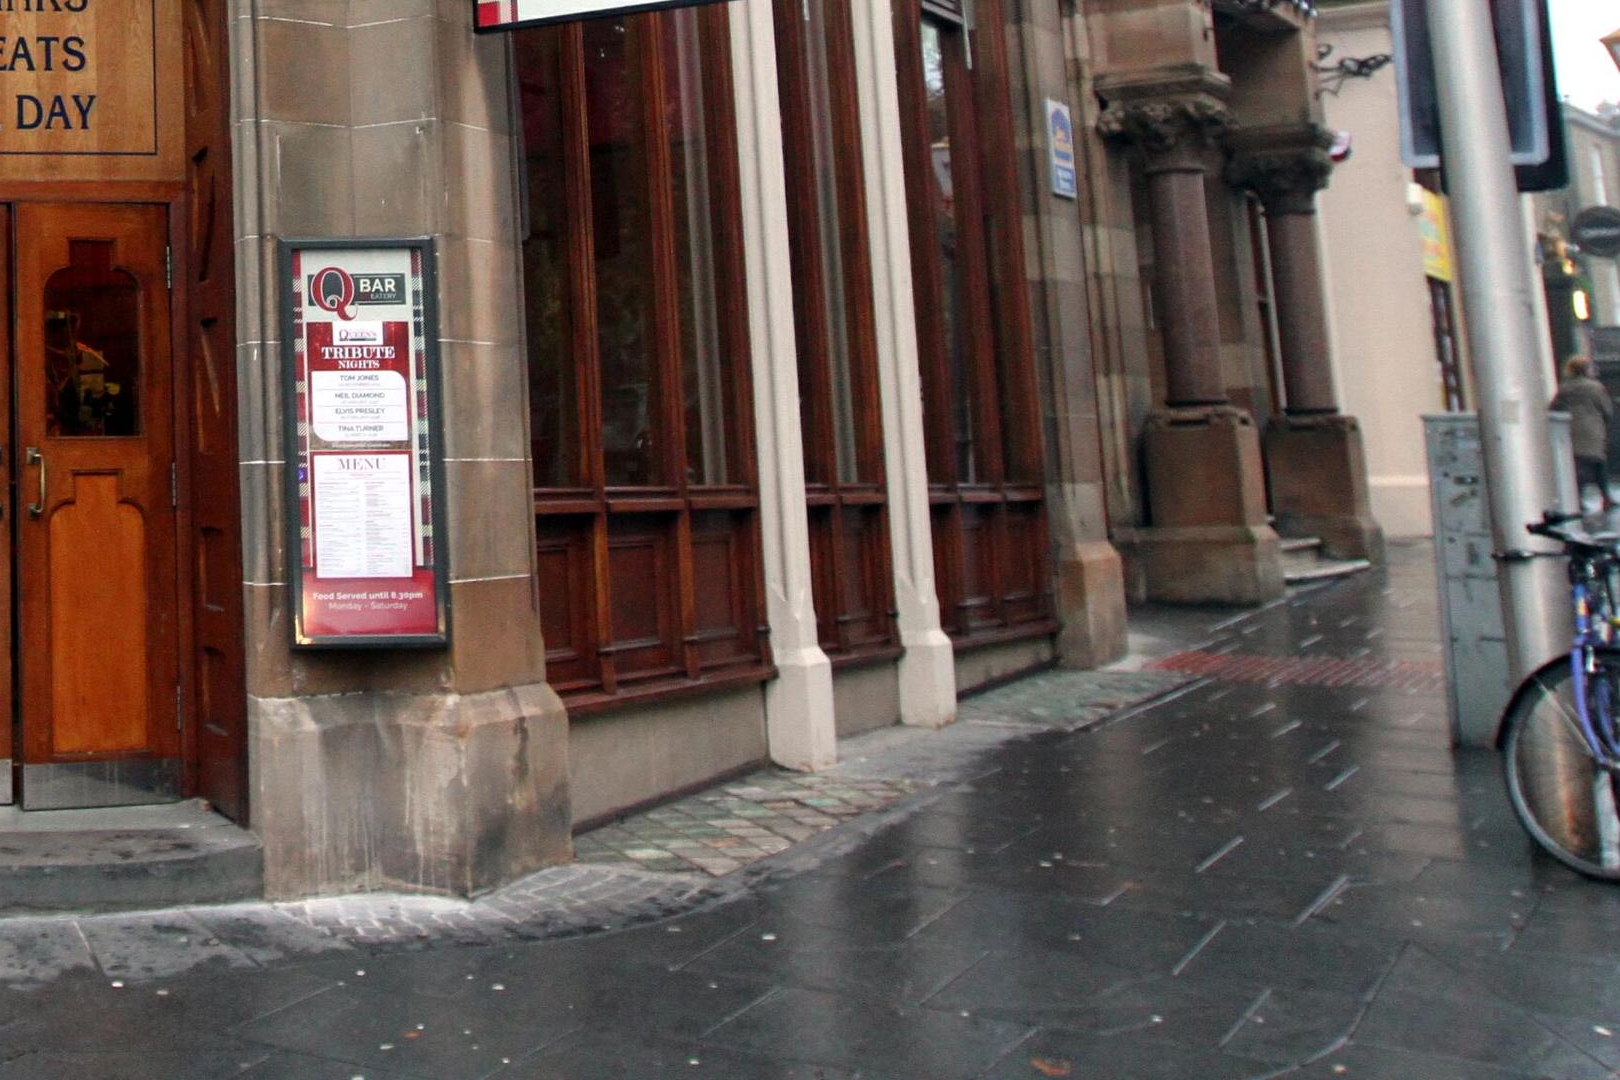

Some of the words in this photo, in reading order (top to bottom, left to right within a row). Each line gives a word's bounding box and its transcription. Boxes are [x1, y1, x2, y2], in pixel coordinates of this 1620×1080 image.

[16, 94, 97, 130] DAY
[310, 266, 358, 321] Q
[359, 278, 396, 293] BAR
[321, 346, 395, 359] TRIBUTE
[338, 359, 380, 369] NIGHTS
[337, 458, 386, 471] MENU
[312, 592, 335, 601] Food
[335, 592, 367, 601] Served
[368, 591, 389, 600] until
[328, 602, 363, 611] Monday
[370, 602, 409, 611] Saturday
